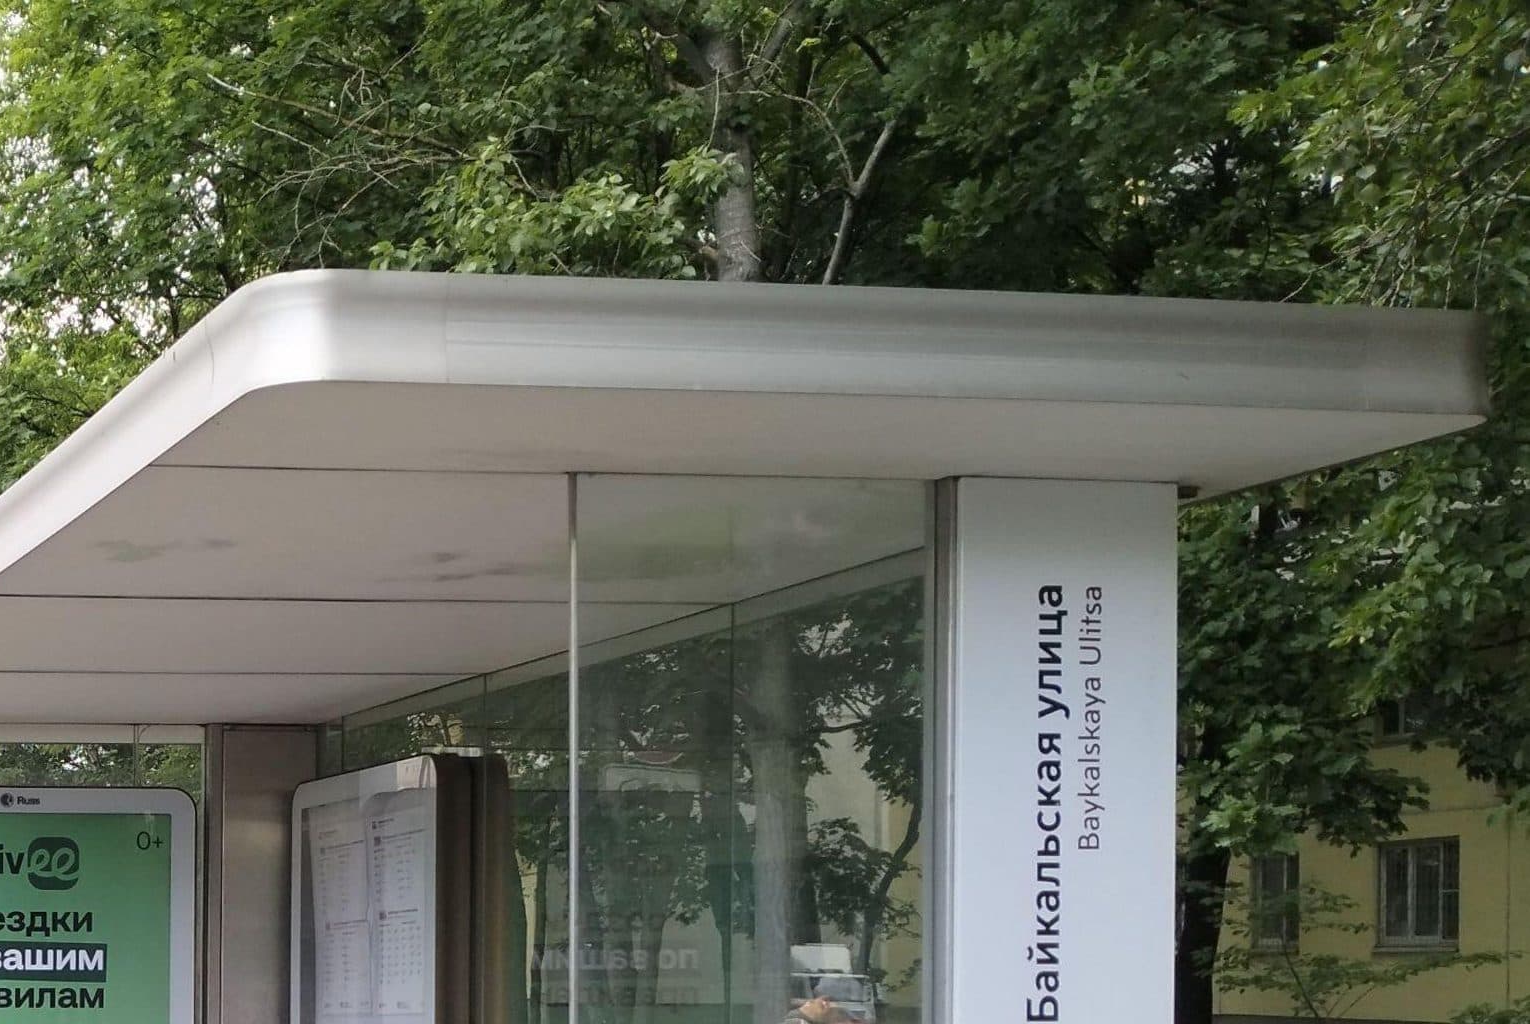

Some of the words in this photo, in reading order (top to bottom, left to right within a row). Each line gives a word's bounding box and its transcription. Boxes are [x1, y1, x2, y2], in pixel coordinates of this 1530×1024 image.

[1037, 584, 1070, 718] улица
[1078, 585, 1103, 665] Ulitsa
[1077, 676, 1107, 850] Baykalskaya
[136, 831, 164, 851] 0+
[1026, 732, 1062, 1023] Байкальская
